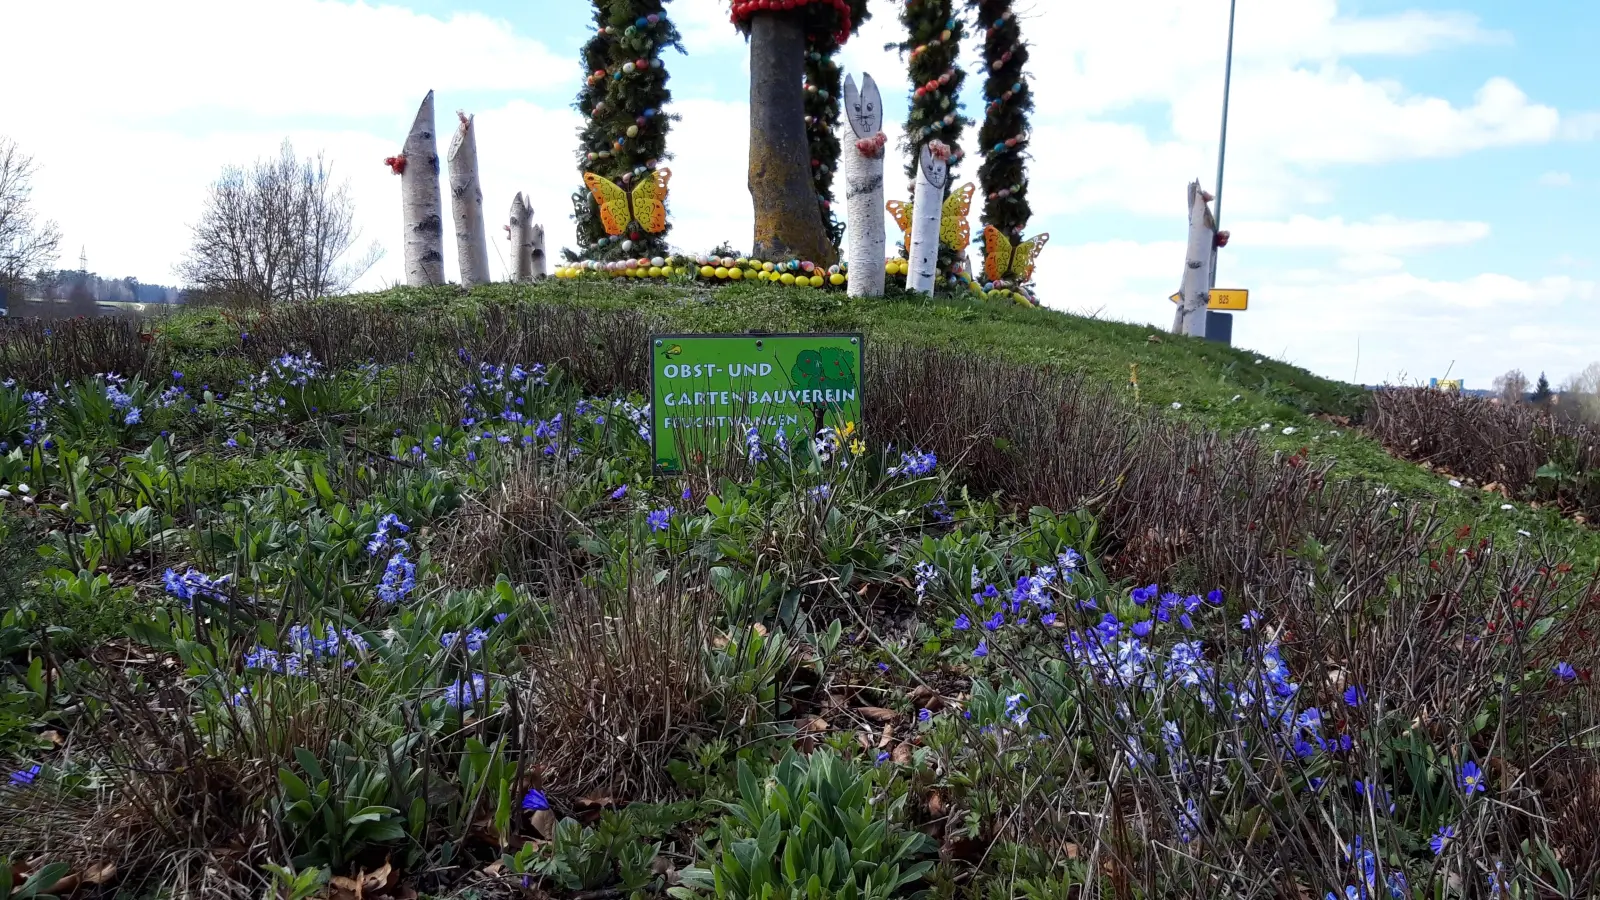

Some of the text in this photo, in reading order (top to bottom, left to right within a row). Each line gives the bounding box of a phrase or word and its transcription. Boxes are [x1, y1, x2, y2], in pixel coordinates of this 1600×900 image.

[1219, 294, 1229, 304] B25
[663, 363, 772, 378] OBST- UND
[664, 389, 855, 406] GARTENBAUVEREIN
